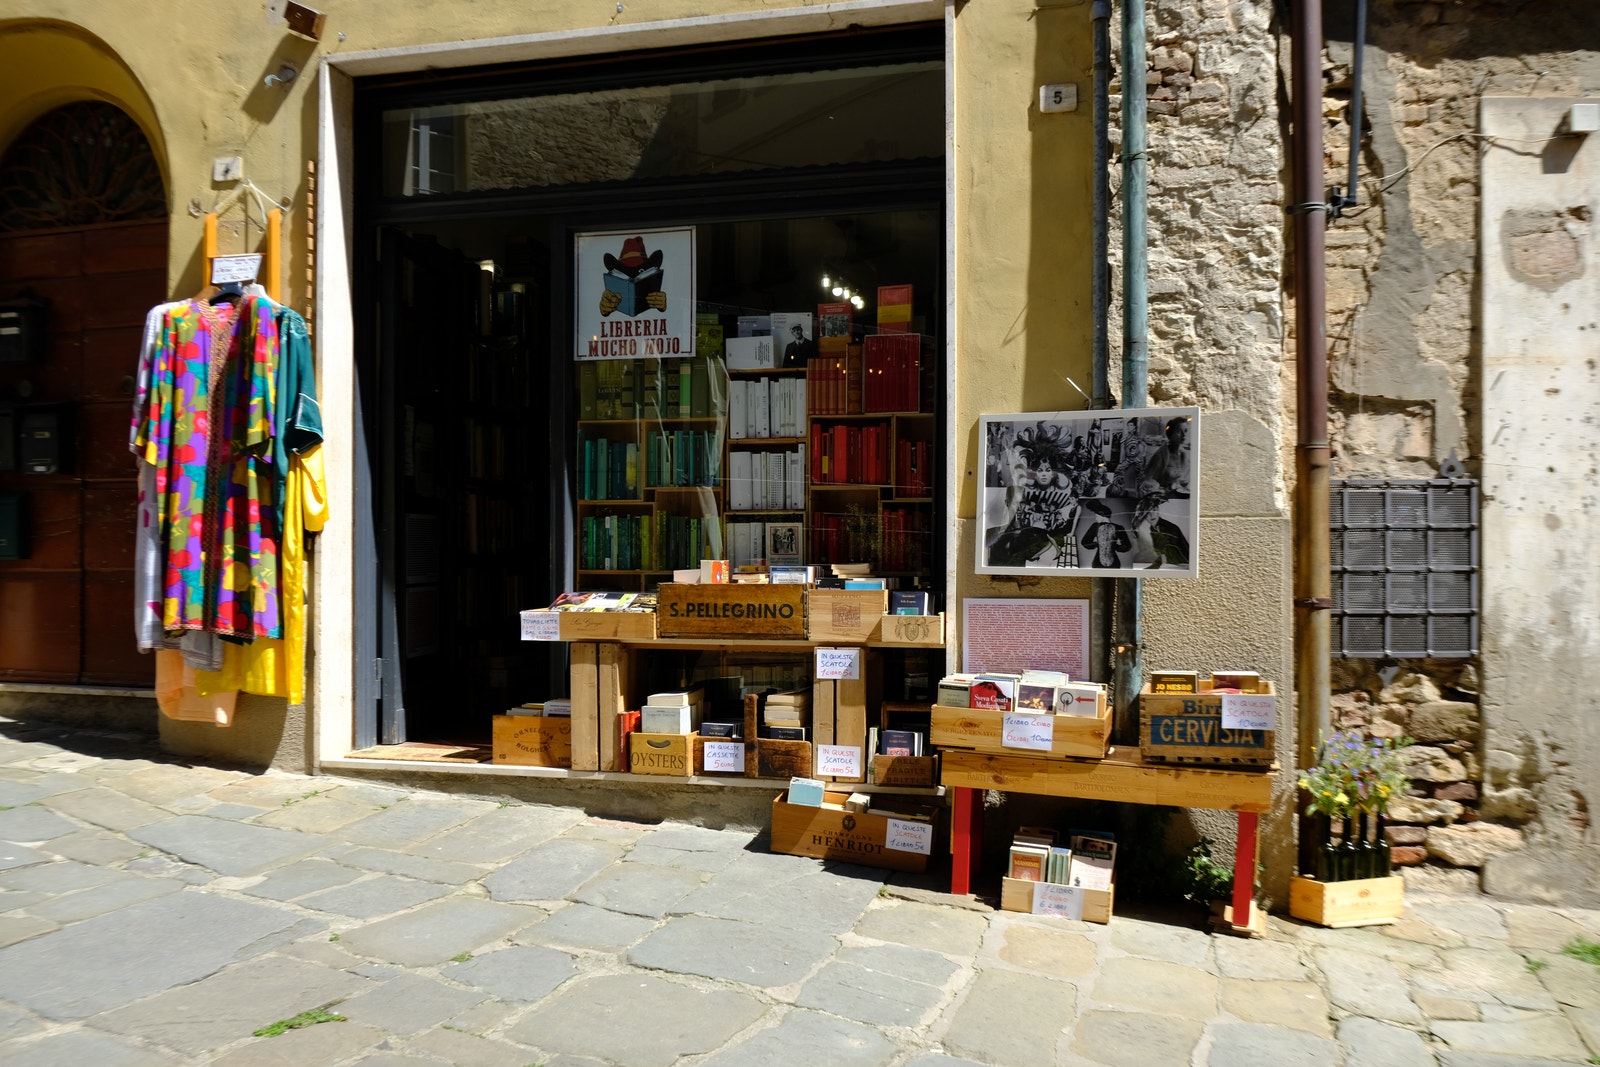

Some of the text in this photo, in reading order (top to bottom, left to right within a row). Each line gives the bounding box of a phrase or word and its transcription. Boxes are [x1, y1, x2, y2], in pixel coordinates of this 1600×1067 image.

[1053, 90, 1062, 105] 5
[600, 319, 668, 338] LIBRERIA
[588, 337, 680, 357] MUCHO MOJO
[669, 602, 794, 619] S.PELLEGRINO
[1182, 699, 1222, 715] Birr
[1226, 708, 1270, 717] SCATOLA
[513, 727, 554, 741] ORNELLAIA
[1159, 719, 1255, 745] CERVISIA
[631, 751, 684, 769] OYSTERS
[707, 751, 739, 759] CASSETTE
[824, 756, 853, 765] SCATOLE
[832, 750, 855, 758] QUESTE
[823, 829, 873, 842] CHAMPAGNE
[902, 824, 927, 834] QUESTE
[812, 834, 885, 855] HENRIOT
